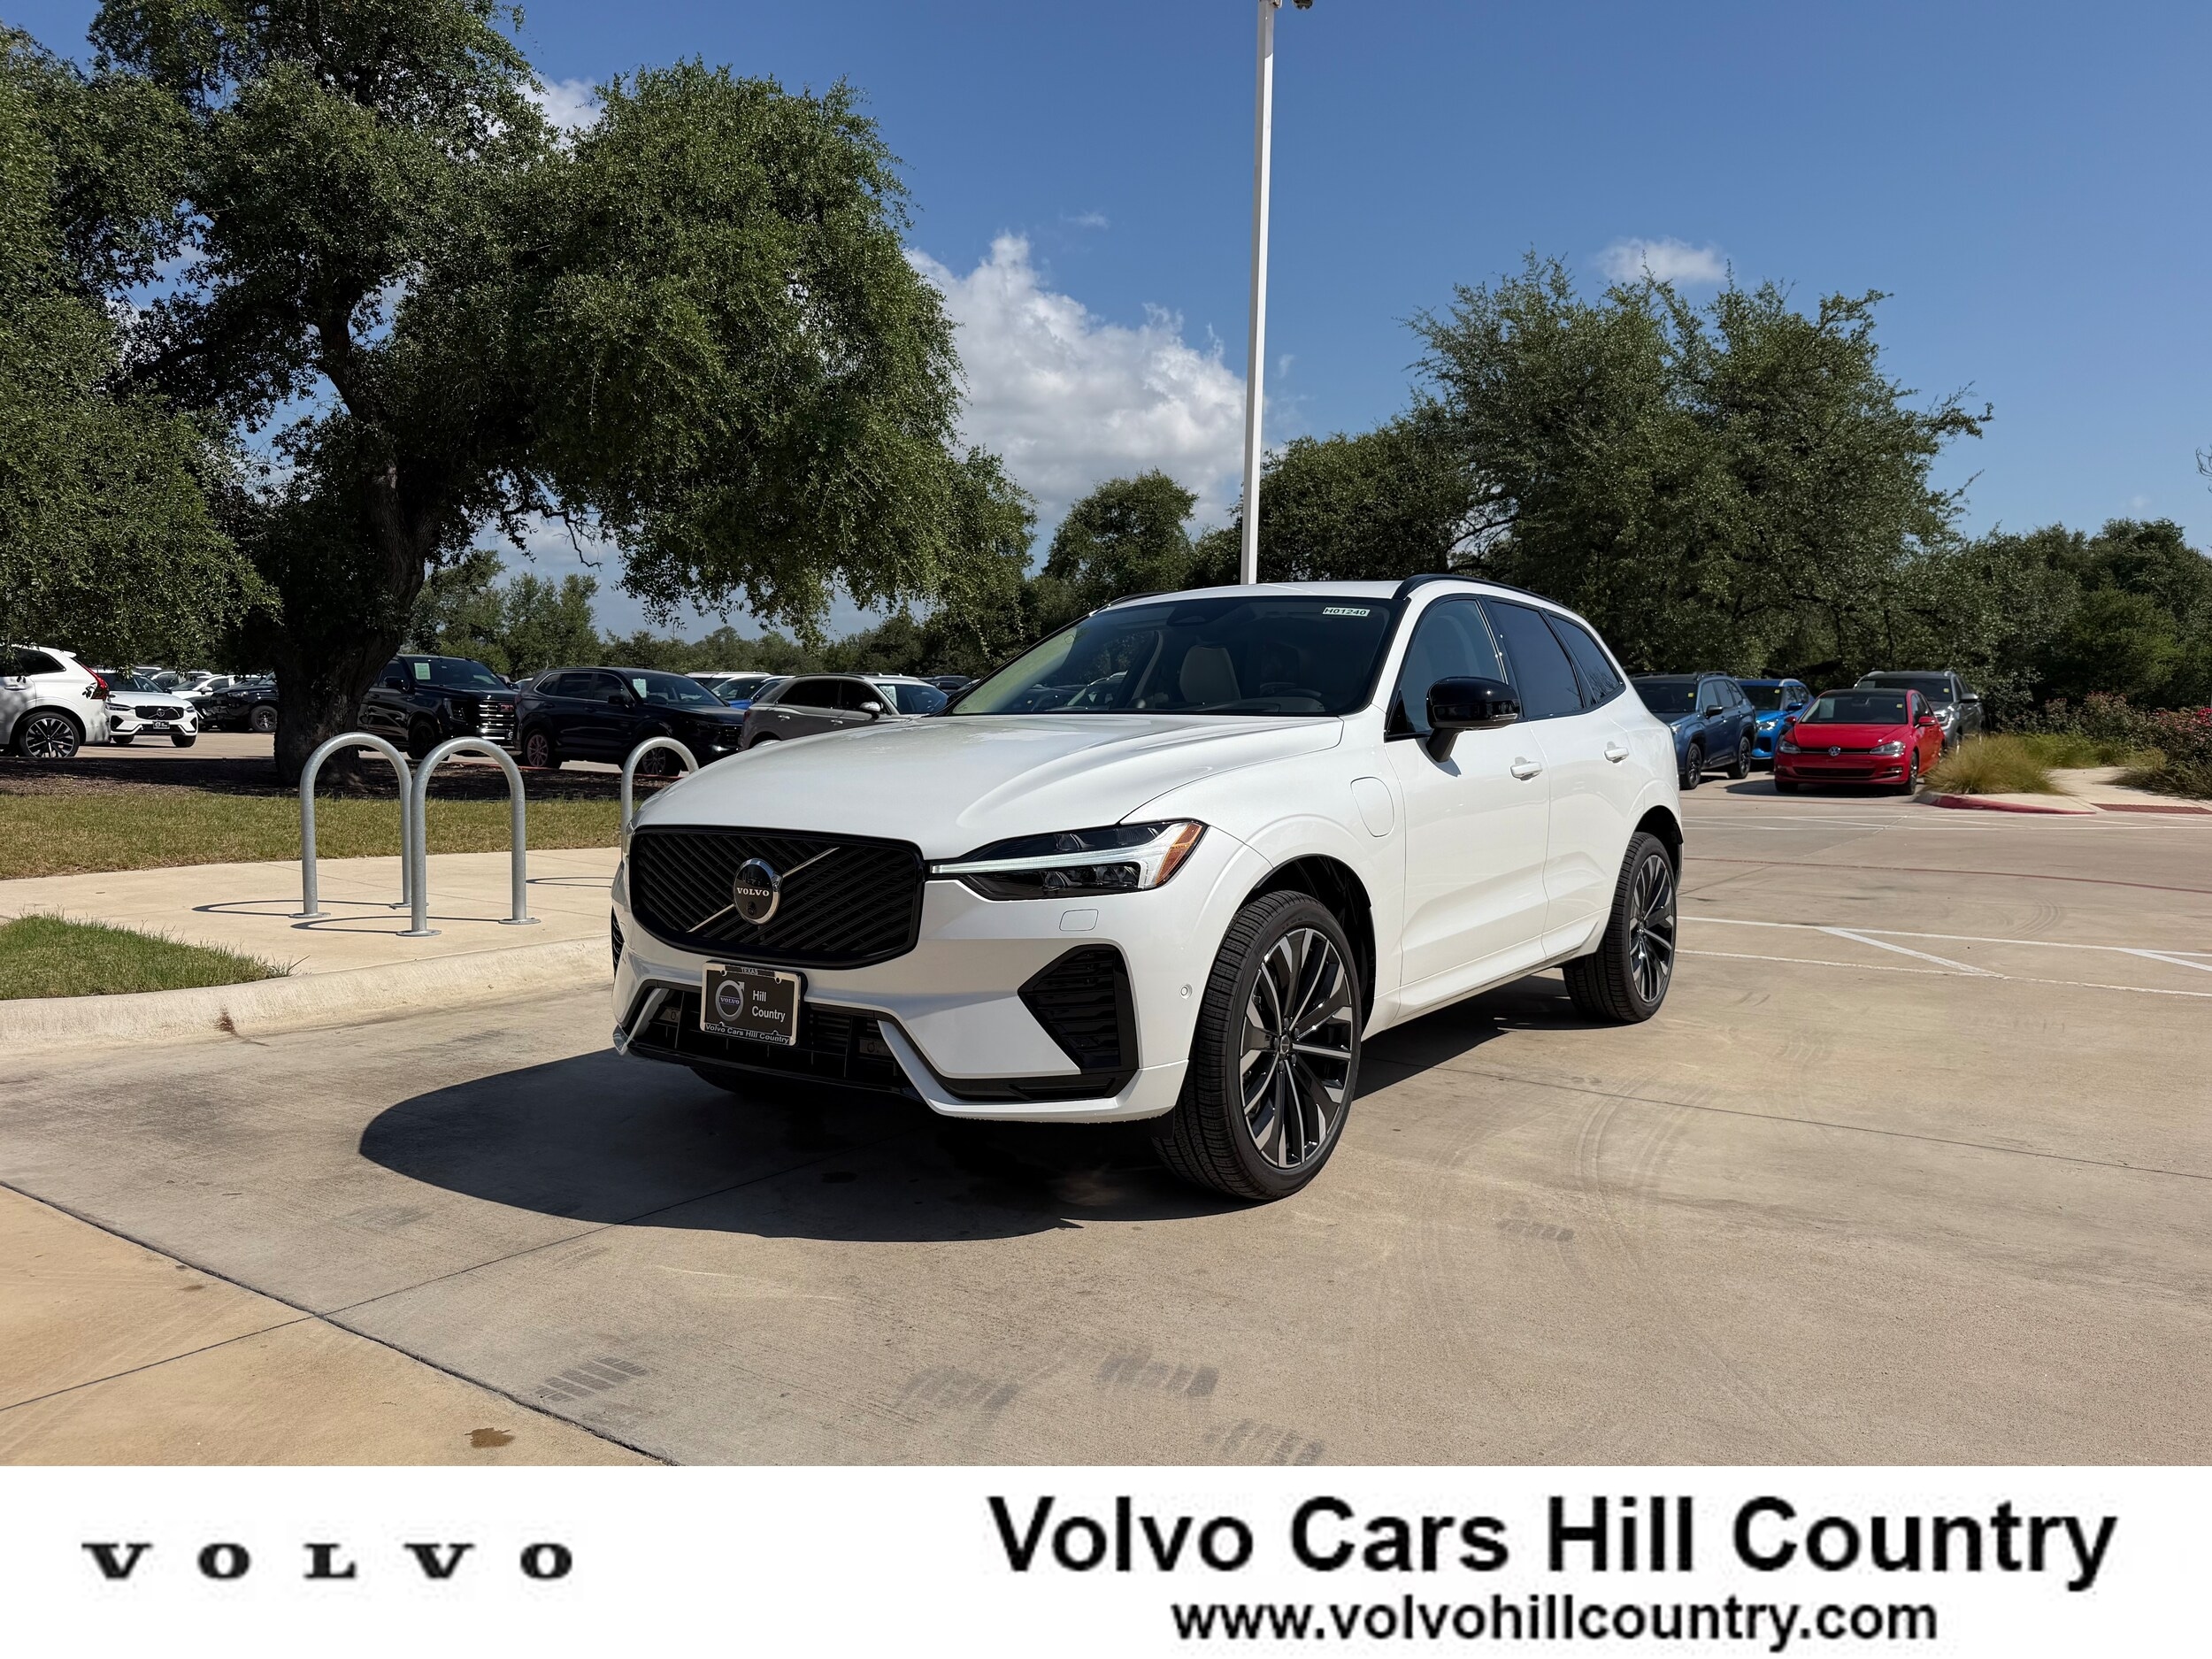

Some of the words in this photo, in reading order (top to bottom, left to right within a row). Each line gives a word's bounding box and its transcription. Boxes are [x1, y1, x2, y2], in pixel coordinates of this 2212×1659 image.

[736, 887, 770, 896] VOLVO
[753, 990, 766, 1002] Hill
[752, 1006, 786, 1022] Country
[705, 1024, 726, 1033] Volvo
[726, 1027, 744, 1036] Cars
[759, 1033, 789, 1044] Country
